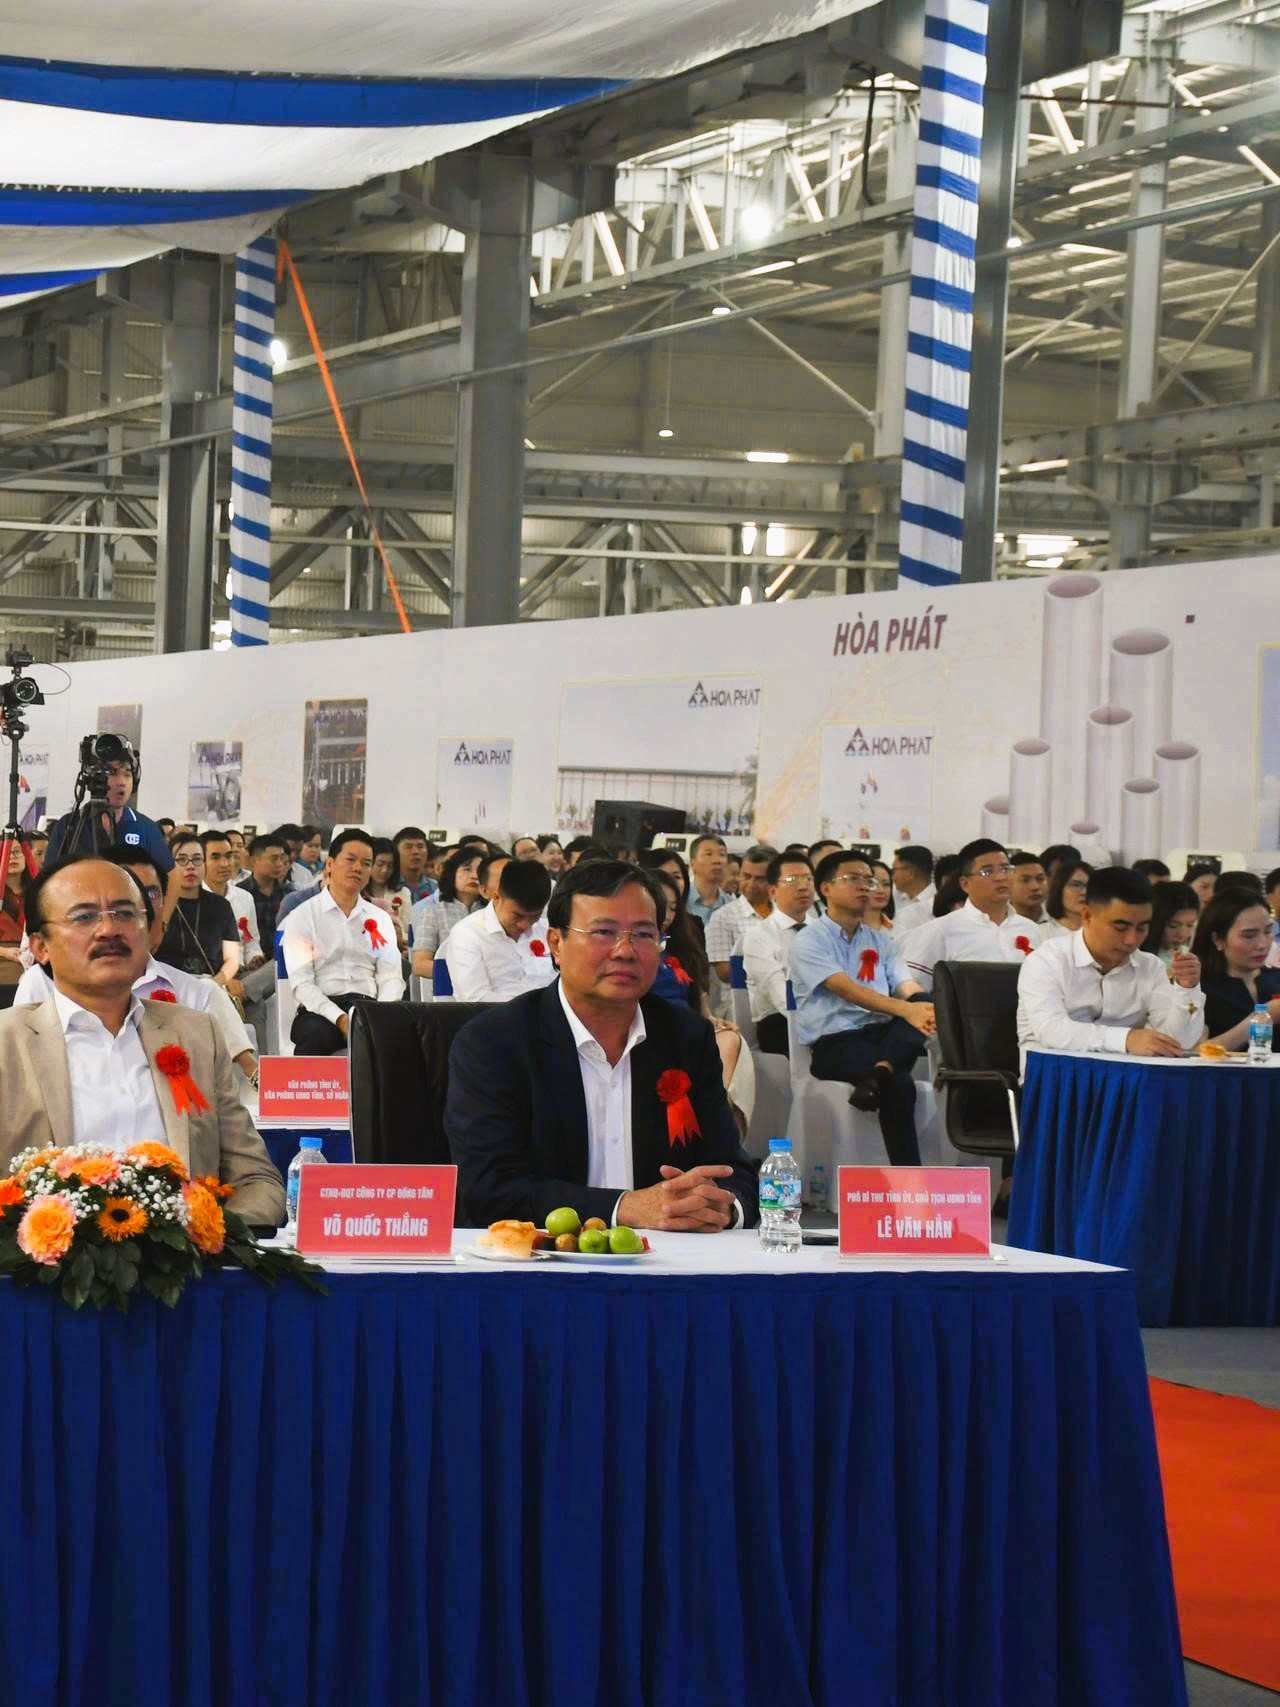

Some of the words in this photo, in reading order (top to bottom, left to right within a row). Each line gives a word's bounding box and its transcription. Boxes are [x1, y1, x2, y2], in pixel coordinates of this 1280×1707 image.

[833, 612, 880, 656] HÒA
[885, 605, 948, 652] PHÁT
[377, 1188, 385, 1199] TY
[386, 1188, 396, 1199] CP
[323, 1214, 341, 1236] VÕ
[345, 1213, 381, 1236] QUỐC
[385, 1212, 428, 1236] THẮNG
[877, 1215, 893, 1238] LÊ
[895, 1215, 922, 1238] VĂN
